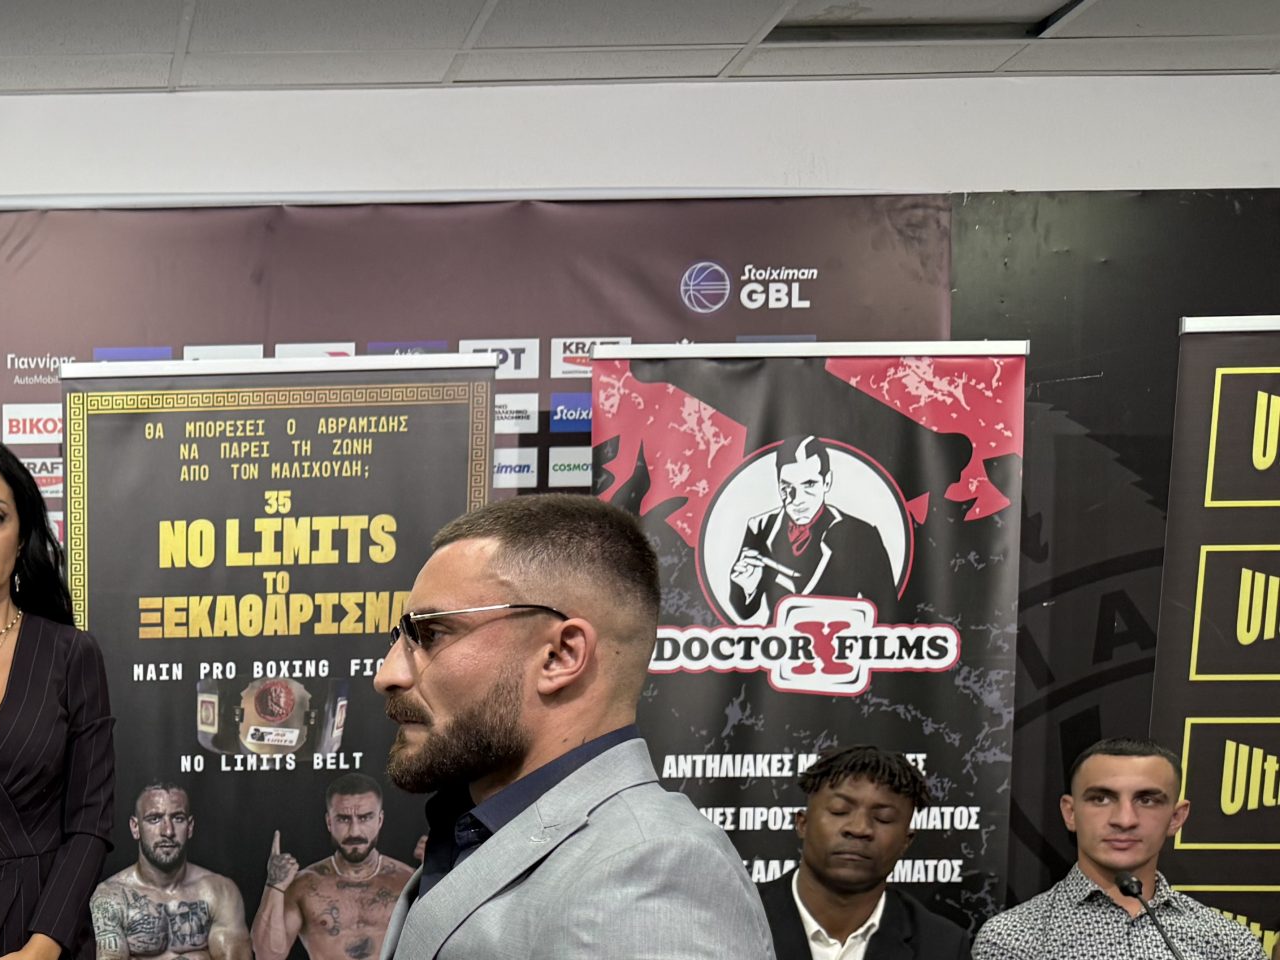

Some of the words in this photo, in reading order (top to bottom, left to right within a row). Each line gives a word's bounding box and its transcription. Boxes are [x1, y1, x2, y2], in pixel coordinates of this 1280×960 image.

[740, 264, 818, 280] Stoiximan
[740, 282, 811, 310] GBL
[145, 422, 164, 440] ΘΑ
[185, 419, 265, 438] ΜΠΟΡΕΣΕΙ
[318, 415, 409, 435] ΑΒΡΑΜΙΔΗΣ
[180, 443, 199, 460] ΝΑ
[220, 441, 270, 459] ΠΑΡΕΙ
[292, 440, 311, 457] ΤΗ
[332, 438, 372, 456] ΖΩΝΗ
[180, 464, 209, 482] ΑΠΟ
[231, 463, 259, 480] ΤΟΝ
[271, 461, 370, 479] ΜΑΛΙΧΟΥΔΗ;
[264, 490, 292, 514] 35
[158, 518, 216, 568] NO
[225, 514, 398, 567] LIMITS
[263, 571, 290, 594] ΤΟ
[653, 635, 815, 662] DOCTOR
[835, 634, 949, 660] FILMS
[133, 663, 183, 681] MAIN
[199, 662, 236, 680] PRO
[253, 660, 330, 678] BOXING
[180, 755, 205, 772] NO
[221, 753, 296, 771] LIMITS
[313, 752, 364, 770] BELT
[662, 753, 794, 778] ΑΝΤΗΛΙΑΚΕΣ
[1220, 739, 1280, 816] Ult
[909, 806, 981, 830] ΜΑΤΟΣ
